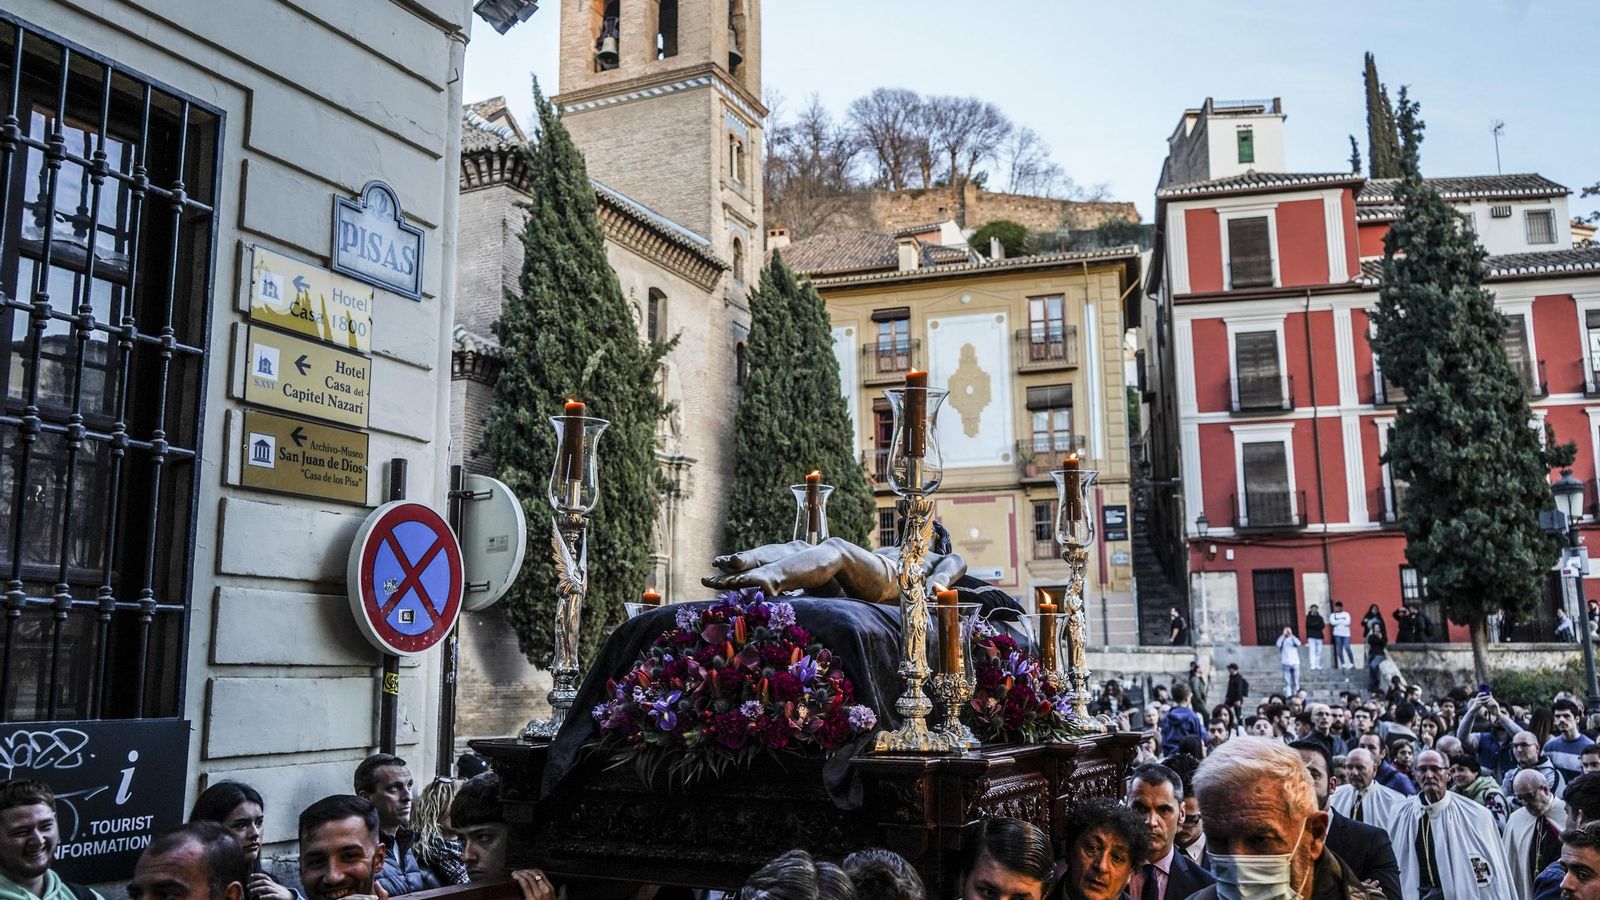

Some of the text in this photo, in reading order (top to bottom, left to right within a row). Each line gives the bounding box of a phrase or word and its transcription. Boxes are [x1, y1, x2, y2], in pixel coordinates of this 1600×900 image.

[340, 220, 415, 275] PISAS
[332, 287, 368, 312] Hotel
[289, 300, 367, 337] Casa 1800
[335, 360, 365, 380] Hotel
[282, 383, 364, 414] Capitel Nazarí
[324, 375, 364, 397] Casa del
[279, 446, 363, 474] San Juan de Dios
[310, 440, 363, 459] Archivo-Museo
[323, 472, 332, 483] de
[333, 474, 343, 484] los
[90, 815, 154, 836] TOURIST
[54, 834, 152, 860] NFORMATION
